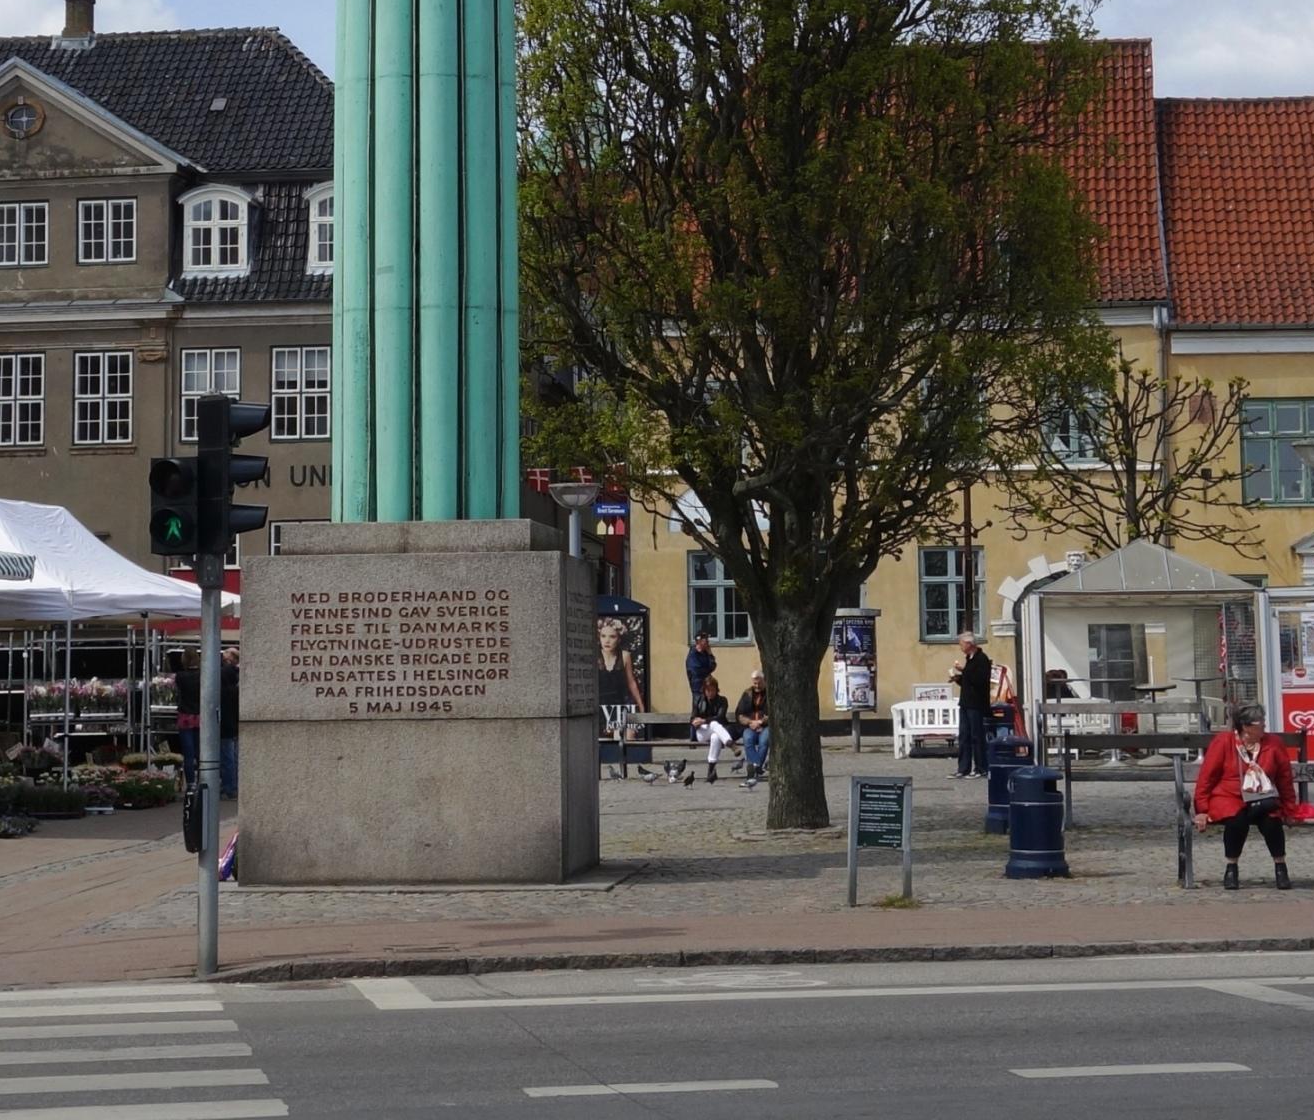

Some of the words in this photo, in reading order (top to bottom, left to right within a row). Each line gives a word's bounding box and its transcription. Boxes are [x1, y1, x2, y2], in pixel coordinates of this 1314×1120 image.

[291, 593, 330, 603] MED
[339, 591, 476, 603] BRODERHAAND
[485, 590, 509, 601] OG
[292, 608, 391, 619] VENNESIND
[399, 607, 431, 618] GAV
[437, 606, 509, 617] SVERIGE
[291, 624, 356, 635] FRELSE
[364, 623, 390, 633] TIL
[400, 621, 509, 633] DANMARKS
[291, 638, 510, 651] FLYGTNINGE-UDRUSTEDE
[291, 656, 322, 666] DEN
[329, 654, 394, 666] DANSKE
[400, 653, 471, 665] BRIGADE
[478, 653, 509, 663] DER
[291, 671, 396, 682] LANDSATTES
[404, 671, 406, 680] I
[414, 669, 509, 680] HELSINGØR
[315, 687, 347, 698] PAA
[356, 685, 486, 697] FRIHEDSDAGEN
[349, 702, 358, 714] 5
[367, 702, 401, 713] MAJ
[410, 701, 452, 712] 1945
